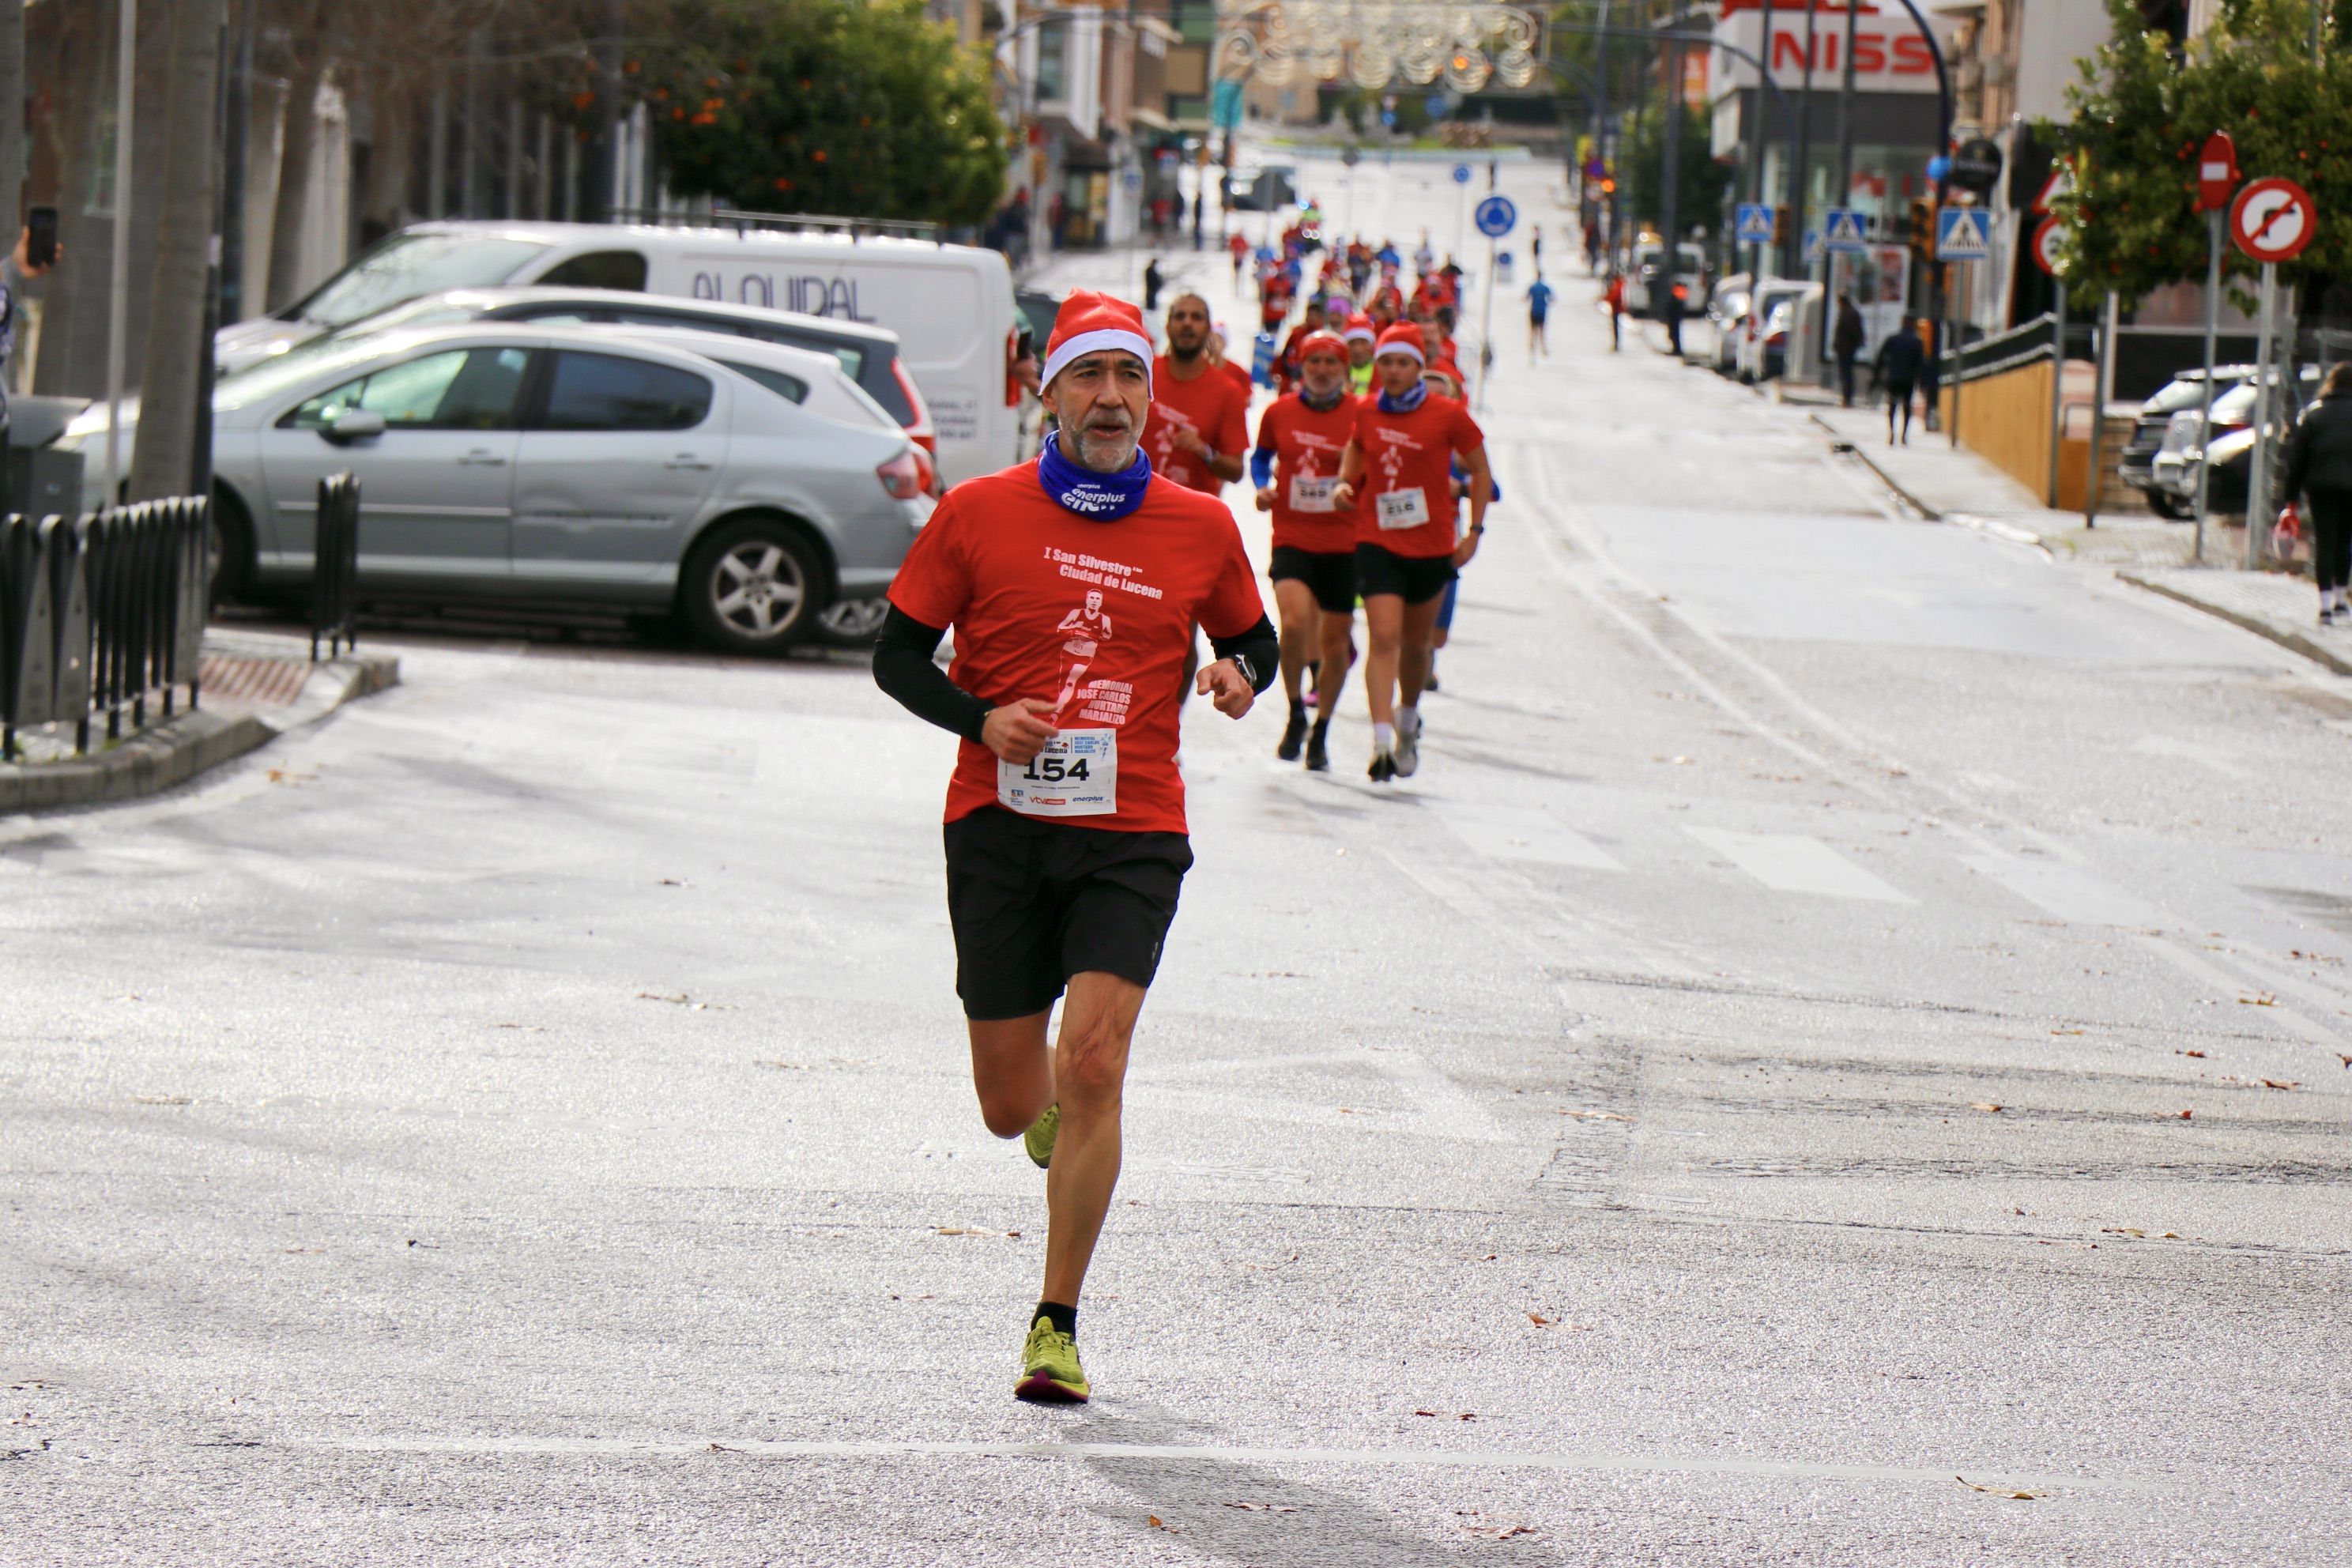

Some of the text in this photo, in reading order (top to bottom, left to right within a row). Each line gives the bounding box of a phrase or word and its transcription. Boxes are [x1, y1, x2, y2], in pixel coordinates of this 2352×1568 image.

[1072, 488, 1126, 504] enerplus
[1043, 546, 1052, 560] I
[1053, 548, 1076, 564] San
[1078, 553, 1132, 577] Silvestre
[1059, 564, 1163, 600] Ciudad de Lucena
[1087, 679, 1133, 695] MEMORIAL
[1076, 688, 1131, 704] JOSE CARLOS
[1087, 699, 1129, 715] HURTADO
[1079, 708, 1126, 725] MARJALIZO
[1023, 757, 1090, 782] 154
